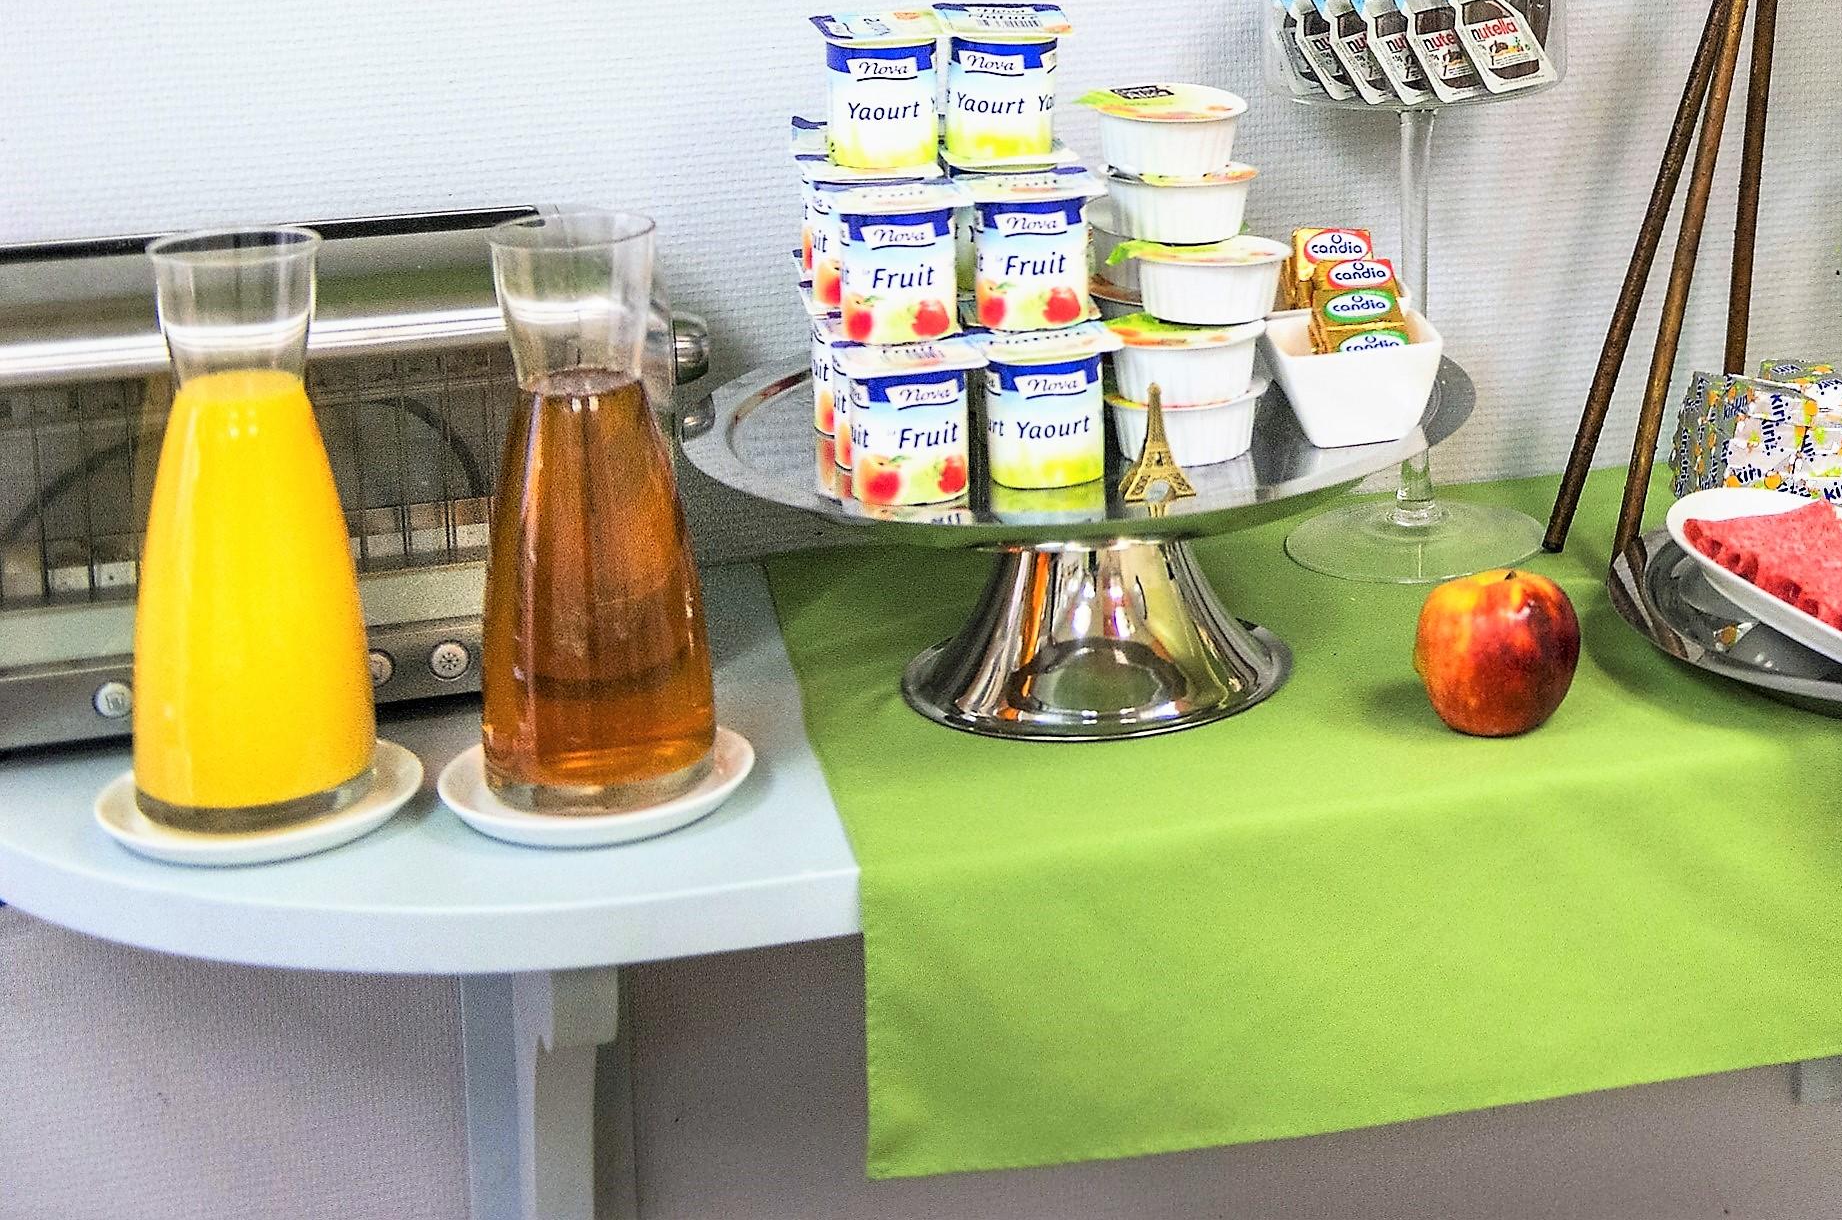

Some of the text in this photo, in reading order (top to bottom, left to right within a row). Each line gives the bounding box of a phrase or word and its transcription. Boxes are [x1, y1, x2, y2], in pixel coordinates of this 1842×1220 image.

[1470, 18, 1519, 41] nutella
[1422, 29, 1455, 51] nute
[857, 61, 910, 76] Nova
[966, 54, 1017, 72] Nova
[847, 100, 921, 122] Yaourt
[956, 91, 1026, 115] Yaourt
[1005, 216, 1058, 231] Nova
[873, 228, 926, 243] Nova
[1311, 241, 1363, 254] candia
[1004, 251, 1067, 277] Fruit
[1335, 267, 1387, 281] candia
[872, 263, 936, 290] Fruit
[1332, 299, 1387, 312] candia
[1026, 377, 1078, 392] Nova
[898, 420, 958, 450] Fruit
[1016, 414, 1090, 440] Yaourt
